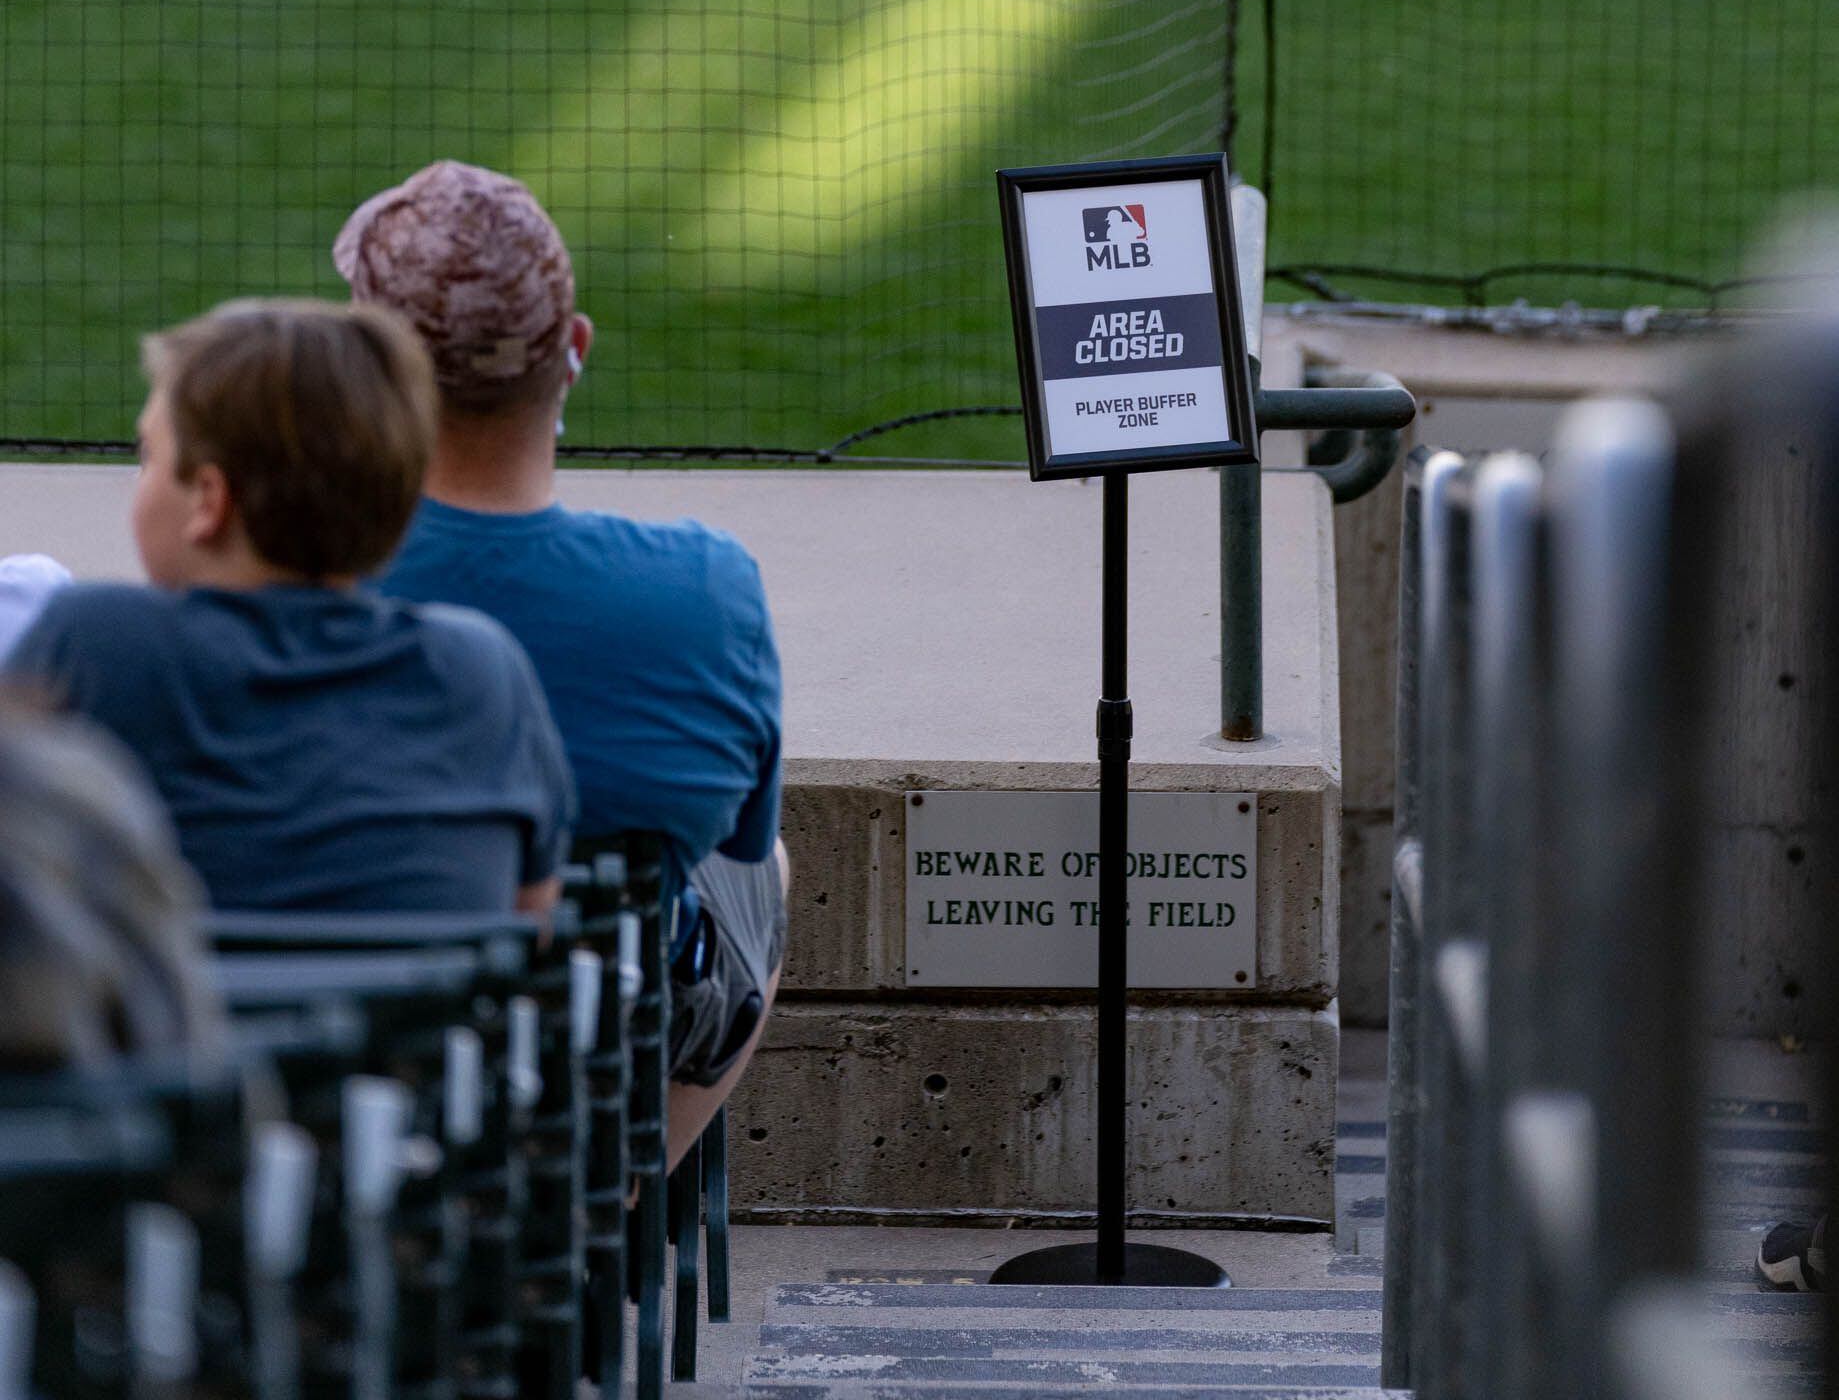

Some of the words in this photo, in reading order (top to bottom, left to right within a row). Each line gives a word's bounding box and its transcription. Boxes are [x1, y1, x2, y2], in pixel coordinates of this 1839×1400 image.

[1086, 242, 1151, 271] MLB
[1089, 309, 1164, 338] AREA
[1075, 333, 1184, 364] CLOSED
[1076, 398, 1134, 416] PLAYER
[1138, 392, 1197, 410] BUFFER
[1118, 412, 1159, 429] ZONE
[915, 851, 1045, 877] BEWARE
[1061, 852, 1100, 877] OF
[927, 900, 1055, 927] LEAVING
[1148, 902, 1236, 928] FIELD
